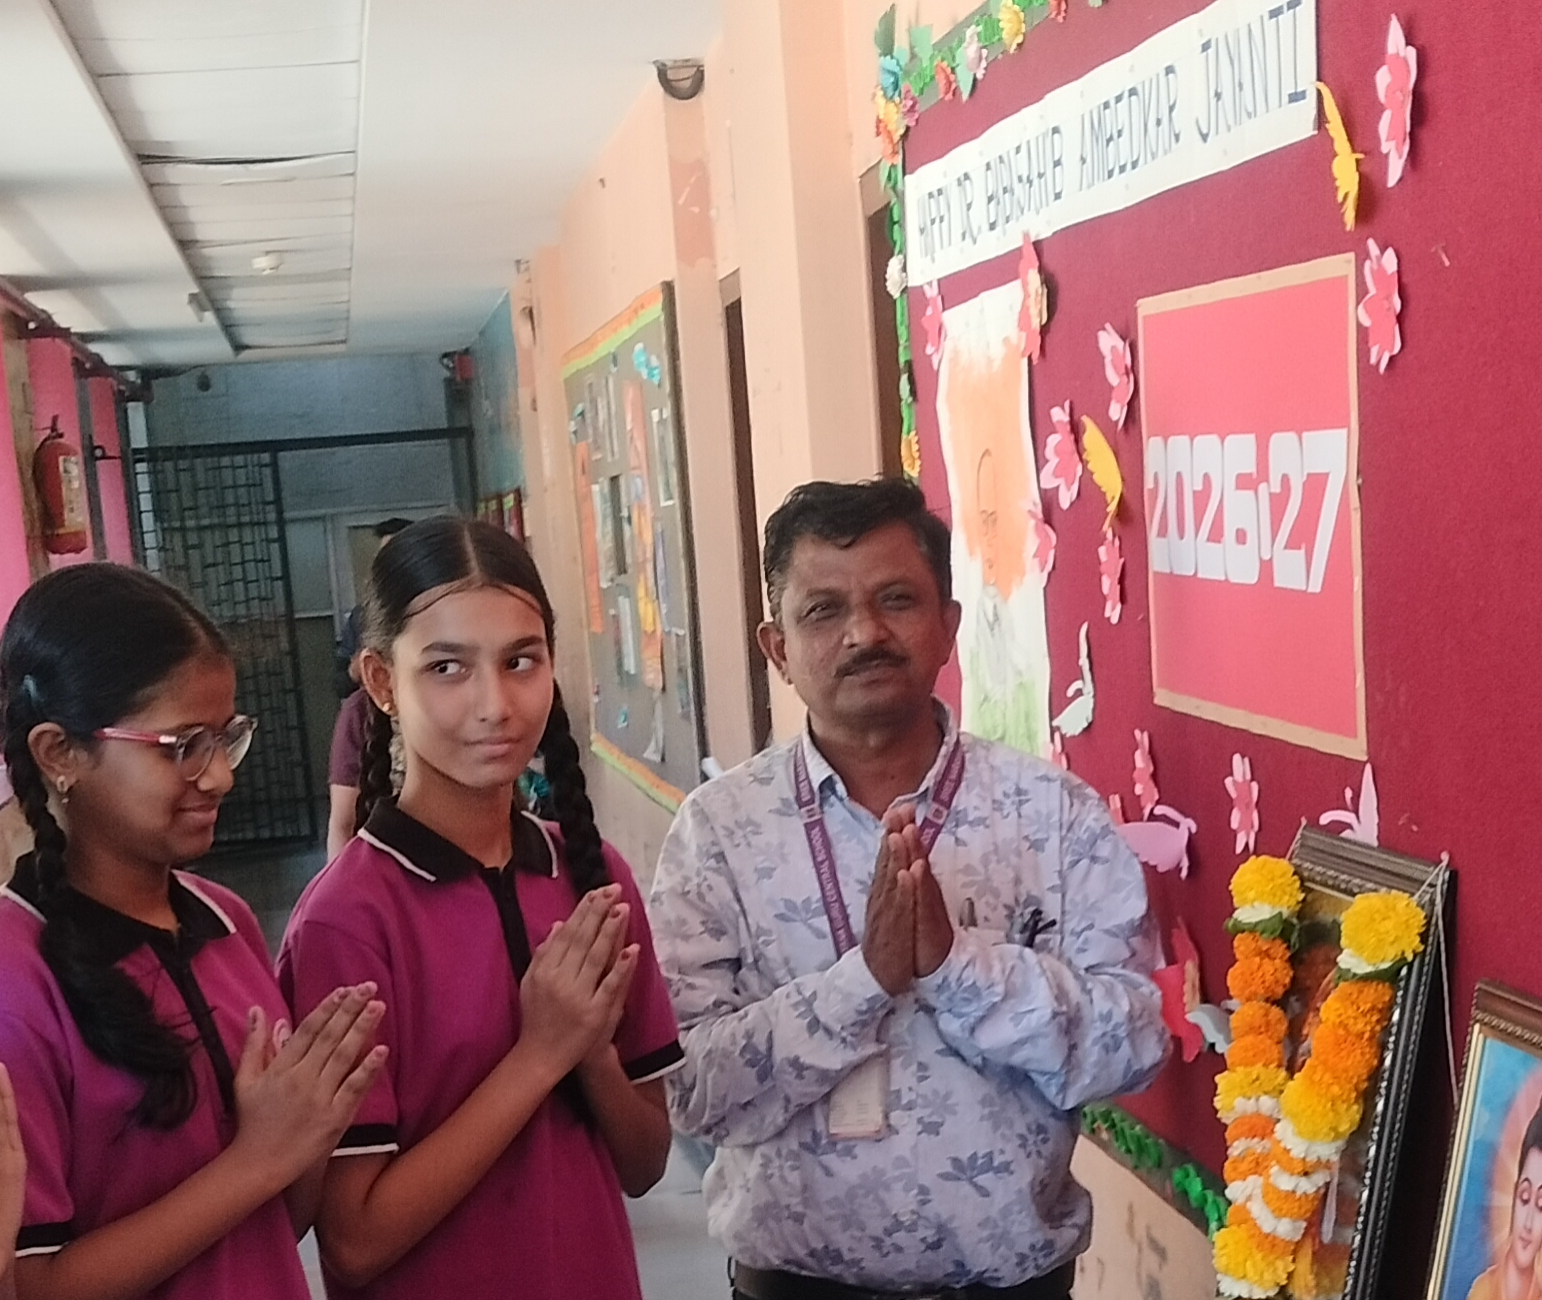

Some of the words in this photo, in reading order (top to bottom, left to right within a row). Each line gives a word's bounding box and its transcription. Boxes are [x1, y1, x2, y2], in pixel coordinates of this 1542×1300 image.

[1080, 64, 1181, 192] AMBEDKAR
[1196, 0, 1307, 144] JAYANTI
[1147, 427, 1349, 593] 2026-27
[810, 825, 827, 862] SCHOOL
[820, 860, 838, 902] CENTRAL
